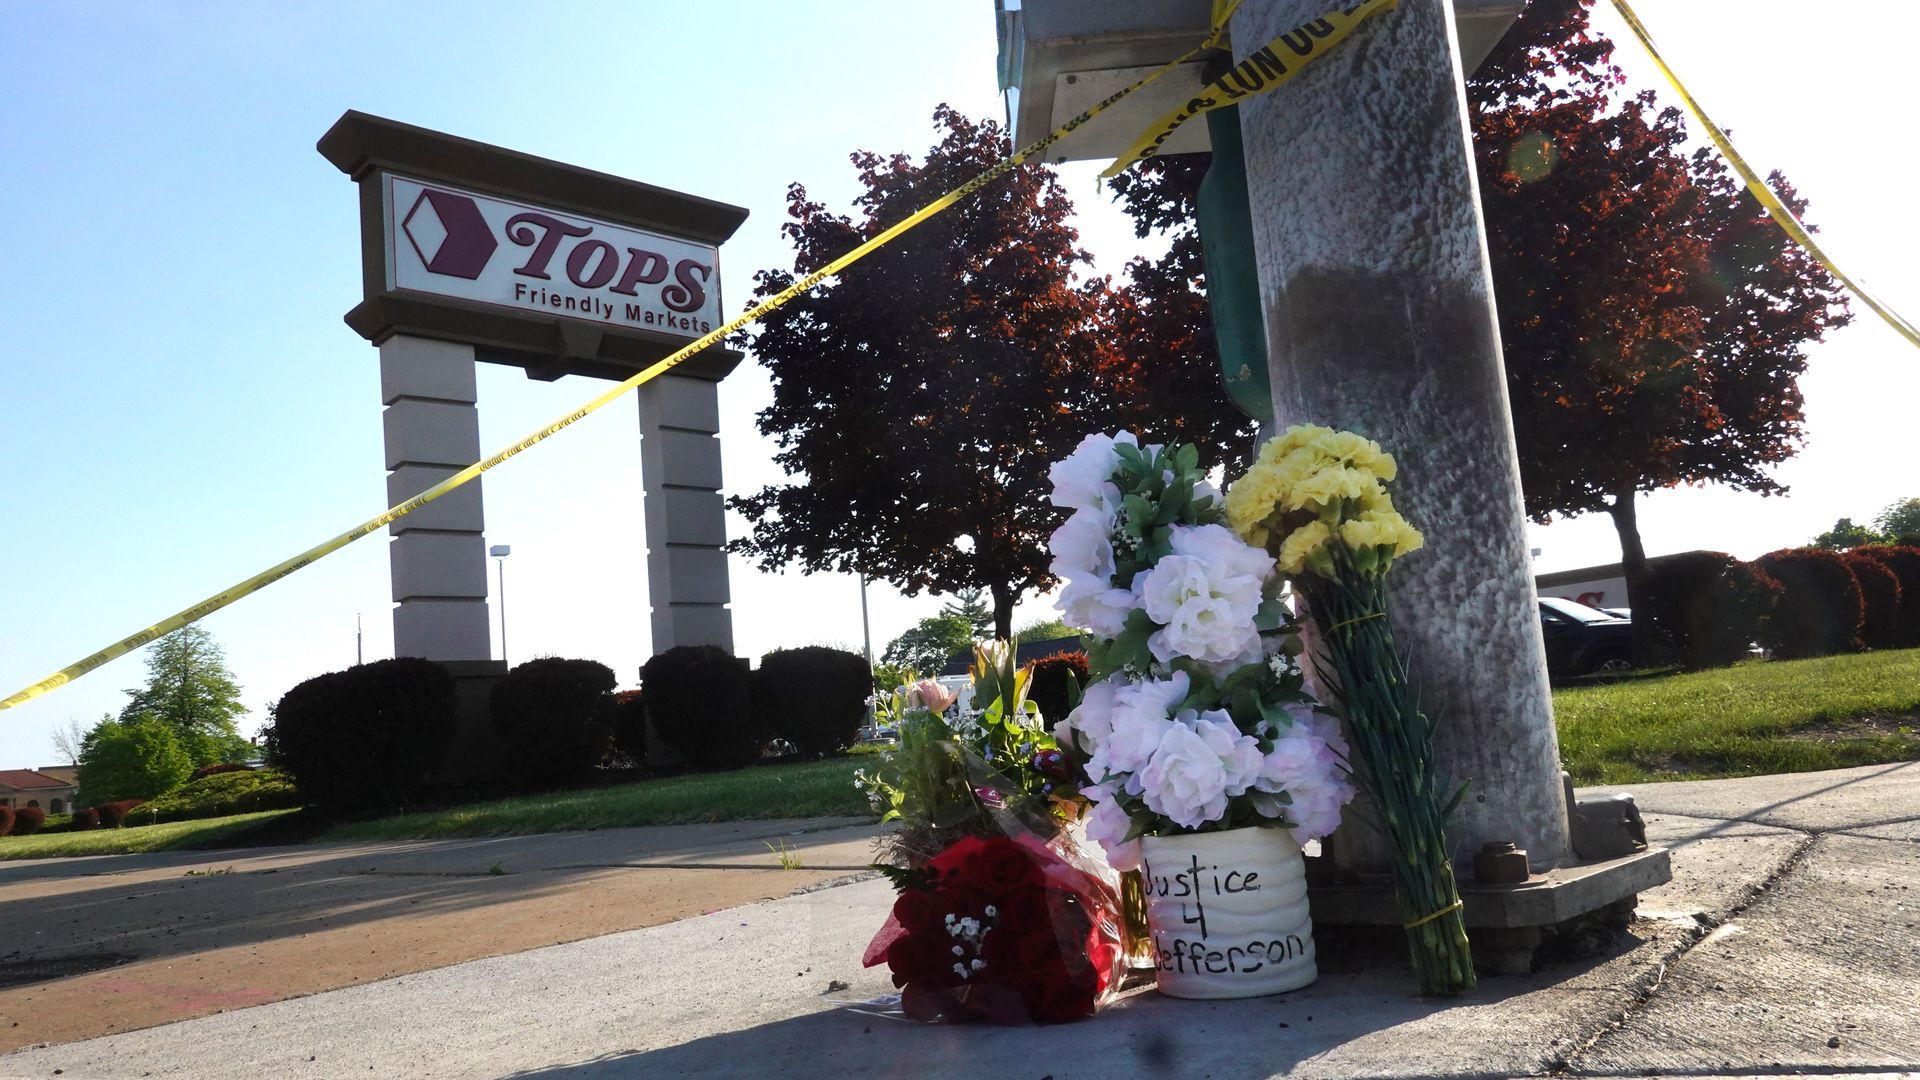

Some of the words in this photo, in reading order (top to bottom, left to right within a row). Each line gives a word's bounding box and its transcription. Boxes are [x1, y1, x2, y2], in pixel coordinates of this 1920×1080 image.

[515, 283, 613, 319] Friendly
[625, 303, 710, 334] Markets
[1144, 855, 1261, 899] Justice
[1182, 901, 1208, 940] 4
[1154, 934, 1304, 975] Jefferson
